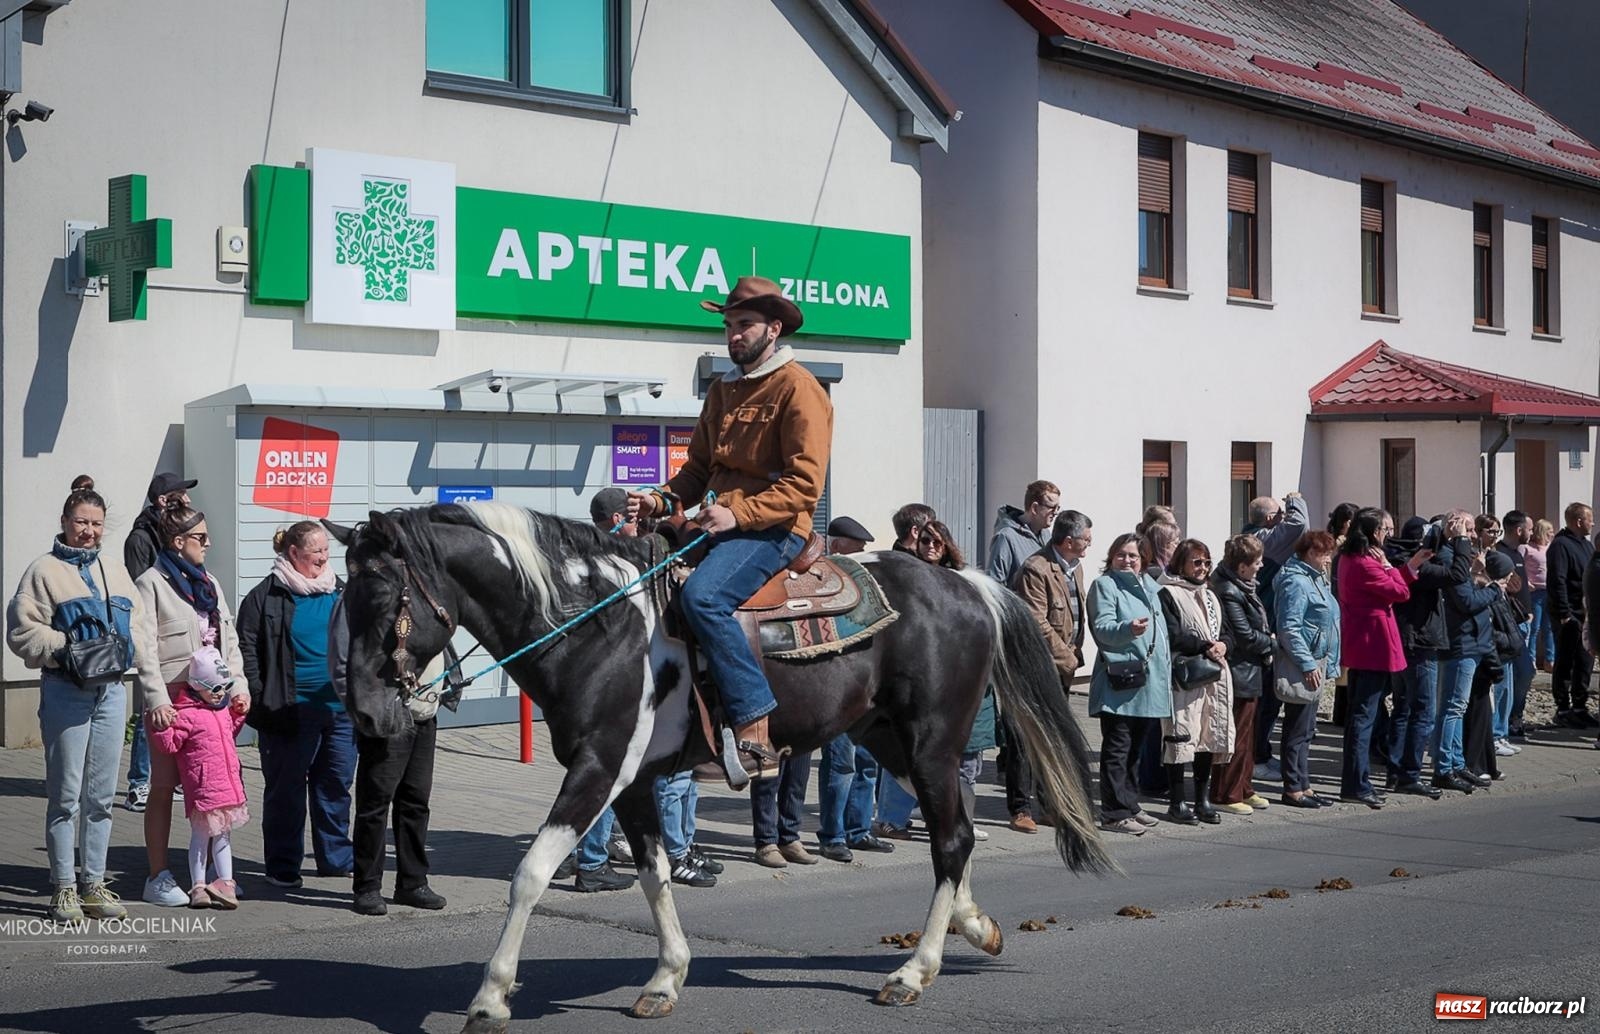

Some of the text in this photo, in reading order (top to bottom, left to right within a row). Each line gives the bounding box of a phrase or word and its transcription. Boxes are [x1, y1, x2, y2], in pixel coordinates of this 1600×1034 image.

[486, 227, 890, 308] APTEKA ZIELONA
[617, 431, 648, 443] allegro
[671, 435, 692, 444] Darm
[265, 450, 327, 468] ORLEN
[266, 471, 327, 488] paczka
